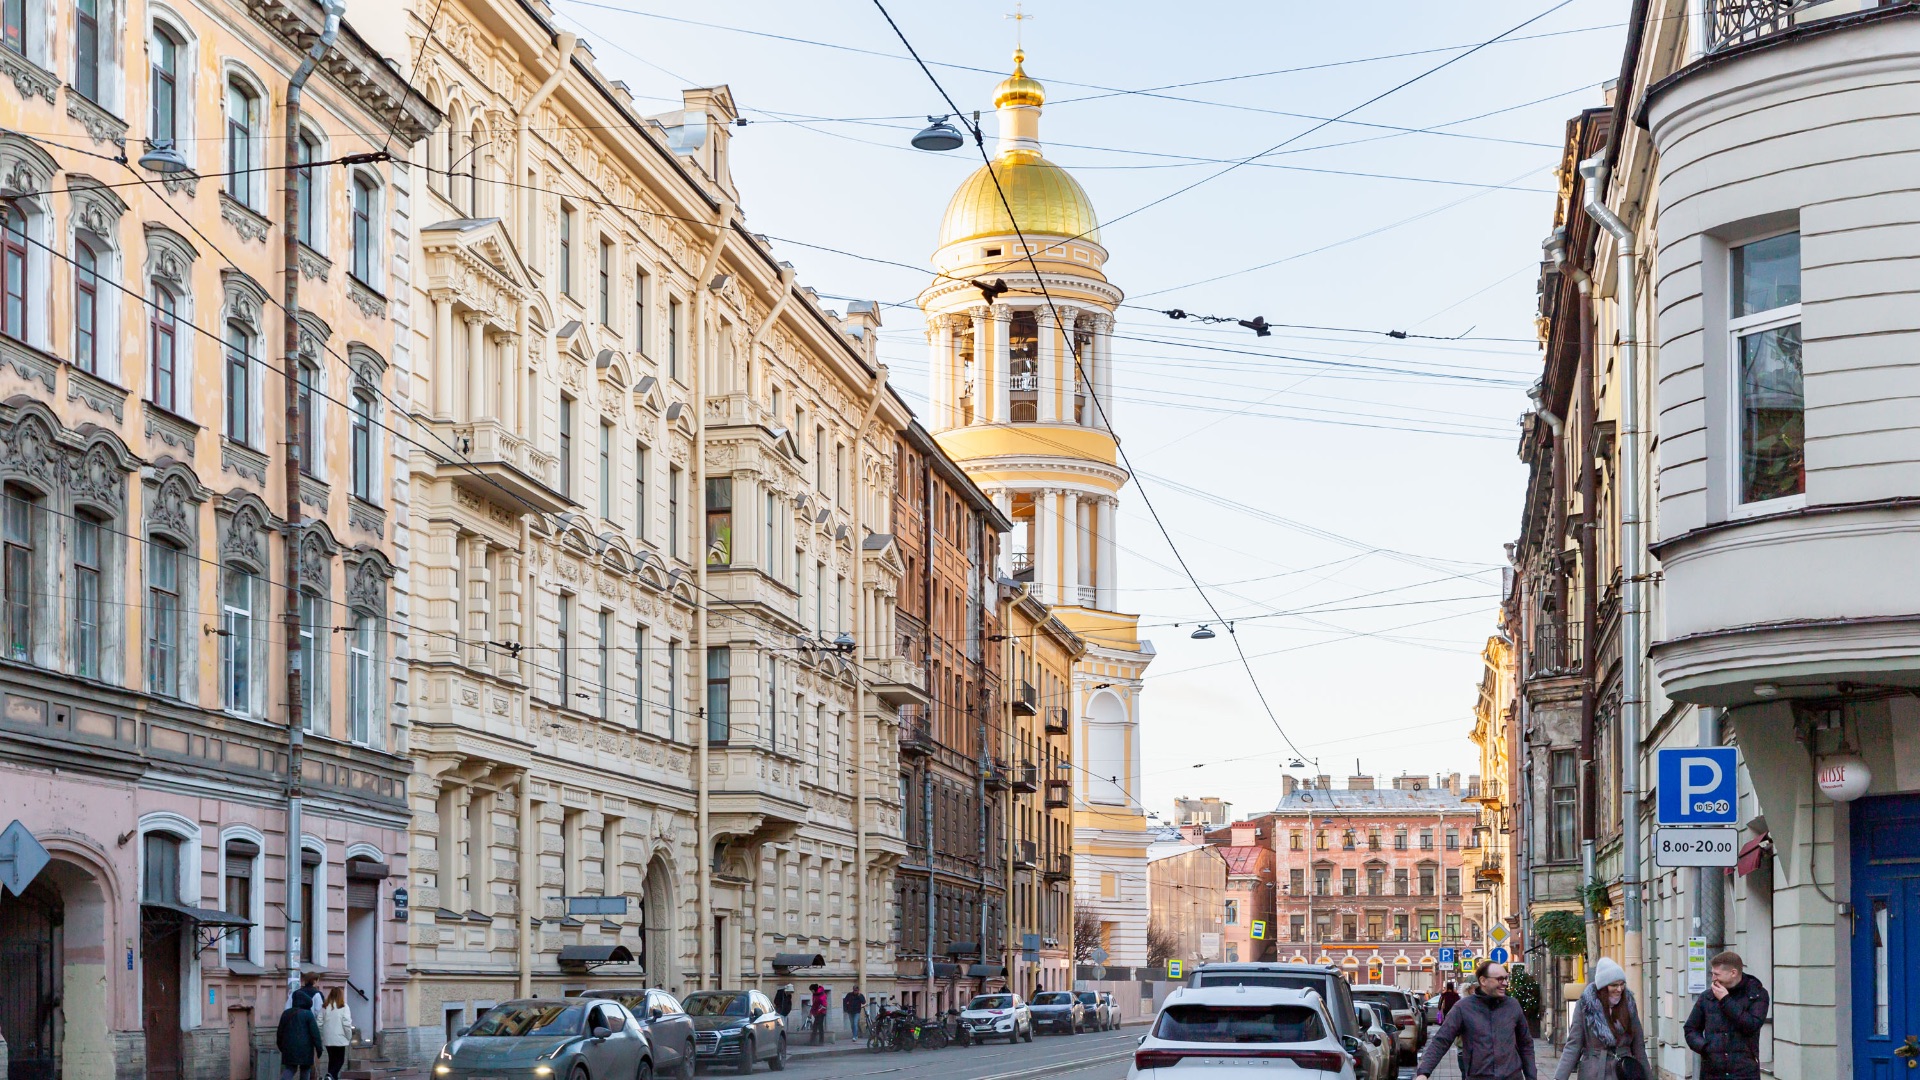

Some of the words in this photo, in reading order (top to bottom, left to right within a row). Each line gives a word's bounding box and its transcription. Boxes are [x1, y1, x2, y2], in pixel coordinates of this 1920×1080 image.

[1818, 766, 1845, 783] ATISSE
[1681, 757, 1722, 815] P
[1715, 803, 1728, 811] 20
[1663, 840, 1732, 852] 8.00-20.00
[1442, 949, 1451, 961] P
